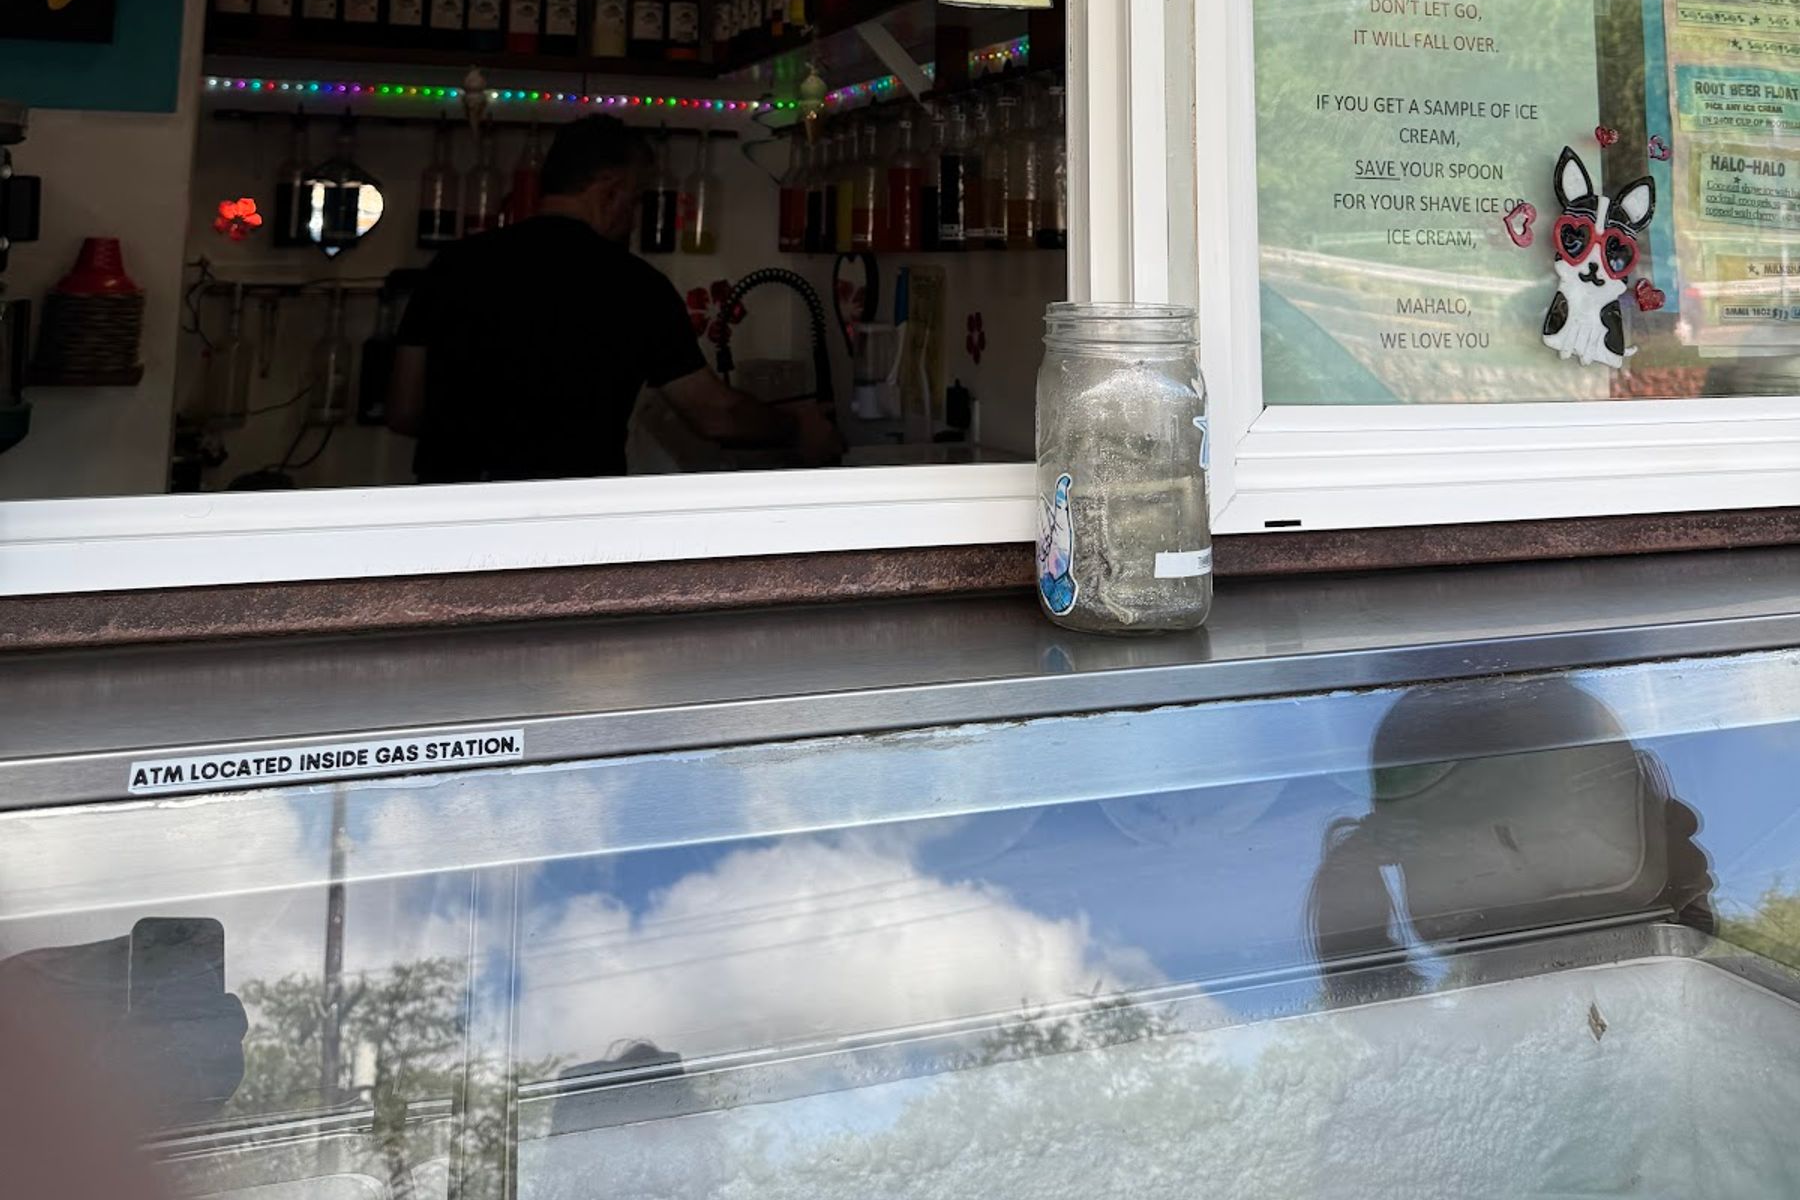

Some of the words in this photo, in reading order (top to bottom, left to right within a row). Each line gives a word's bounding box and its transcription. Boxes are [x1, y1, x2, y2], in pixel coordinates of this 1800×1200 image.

[1424, 1, 1450, 17] LET
[1454, 4, 1482, 22] GO,
[1353, 29, 1368, 45] IT
[1372, 31, 1410, 48] WILL
[1414, 33, 1449, 50] FALL
[1453, 35, 1500, 53] OVER.
[1695, 81, 1726, 96] ROOT
[1729, 84, 1761, 98] BEER
[1316, 94, 1330, 110] IF
[1334, 96, 1368, 112] YOU
[1373, 97, 1404, 114] GET
[1408, 99, 1420, 114] A
[1424, 100, 1486, 118] SAMPLE
[1490, 102, 1511, 119] OF
[1515, 104, 1539, 120] ICE
[1725, 103, 1740, 112] ANY
[1400, 128, 1461, 148] CREAM,
[1355, 159, 1397, 177] SAVE
[1400, 161, 1445, 178] YOUR
[1449, 163, 1504, 180] SPOON
[1710, 154, 1786, 178] HALO-HALO
[1333, 193, 1365, 210] FOR
[1370, 195, 1415, 212] YOUR
[1420, 196, 1471, 212] SHAVE
[1476, 198, 1500, 213] ICE
[1387, 229, 1410, 245] ICE
[1416, 230, 1477, 249] CREAM,
[1397, 298, 1472, 317] MAHALO,
[1380, 333, 1407, 349] WE
[1412, 333, 1451, 349] LOVE
[1456, 333, 1490, 349] YOU
[132, 767, 184, 787] ATM
[190, 756, 292, 781] LOCATED
[299, 749, 369, 772] INSIDE
[375, 744, 420, 763] GAS
[425, 735, 521, 760] STATION.
